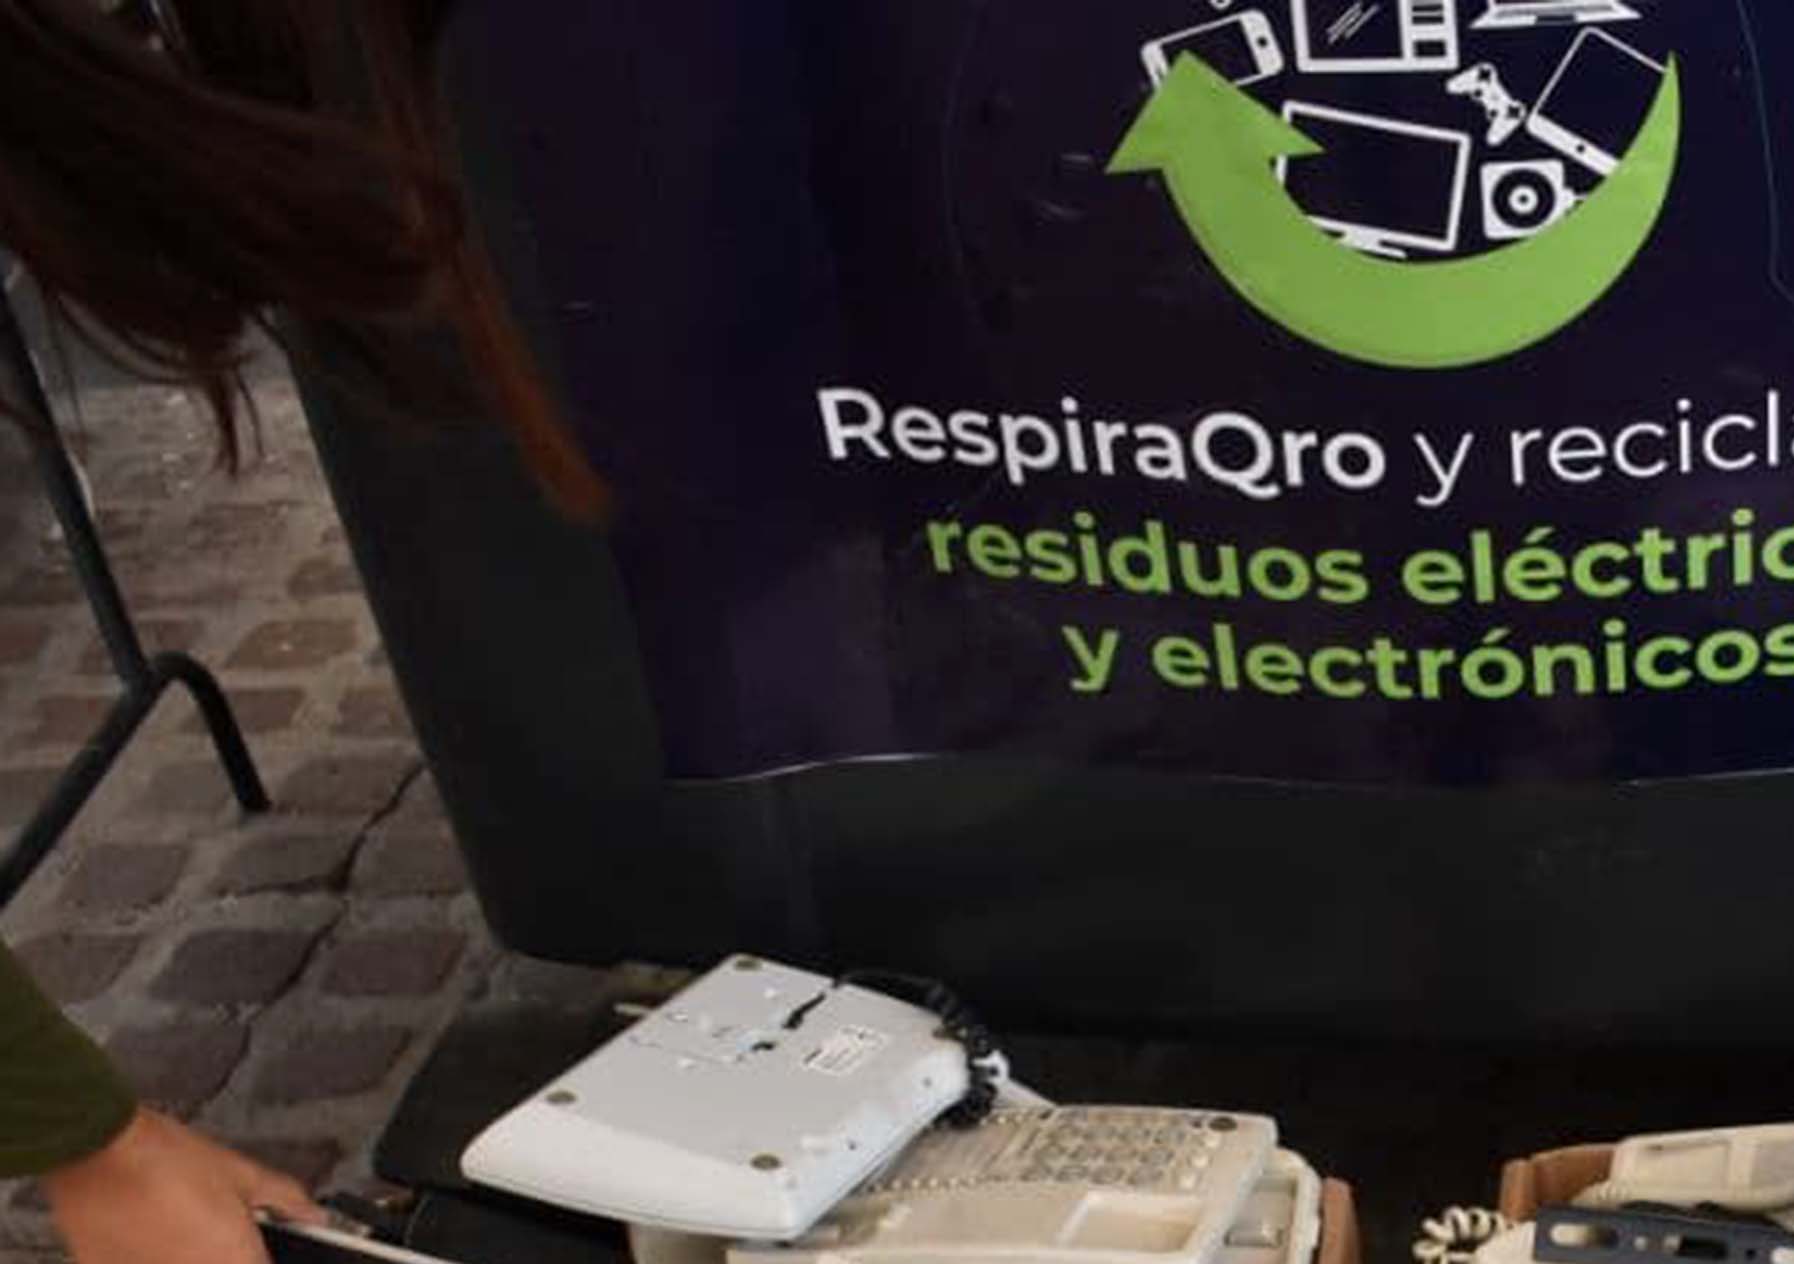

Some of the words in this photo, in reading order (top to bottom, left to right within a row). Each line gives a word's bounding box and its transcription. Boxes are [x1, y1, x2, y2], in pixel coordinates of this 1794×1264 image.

[817, 387, 1386, 499] RespiraQro
[1413, 432, 1475, 507] y
[925, 510, 1369, 604] residuos
[1062, 626, 1118, 690] y
